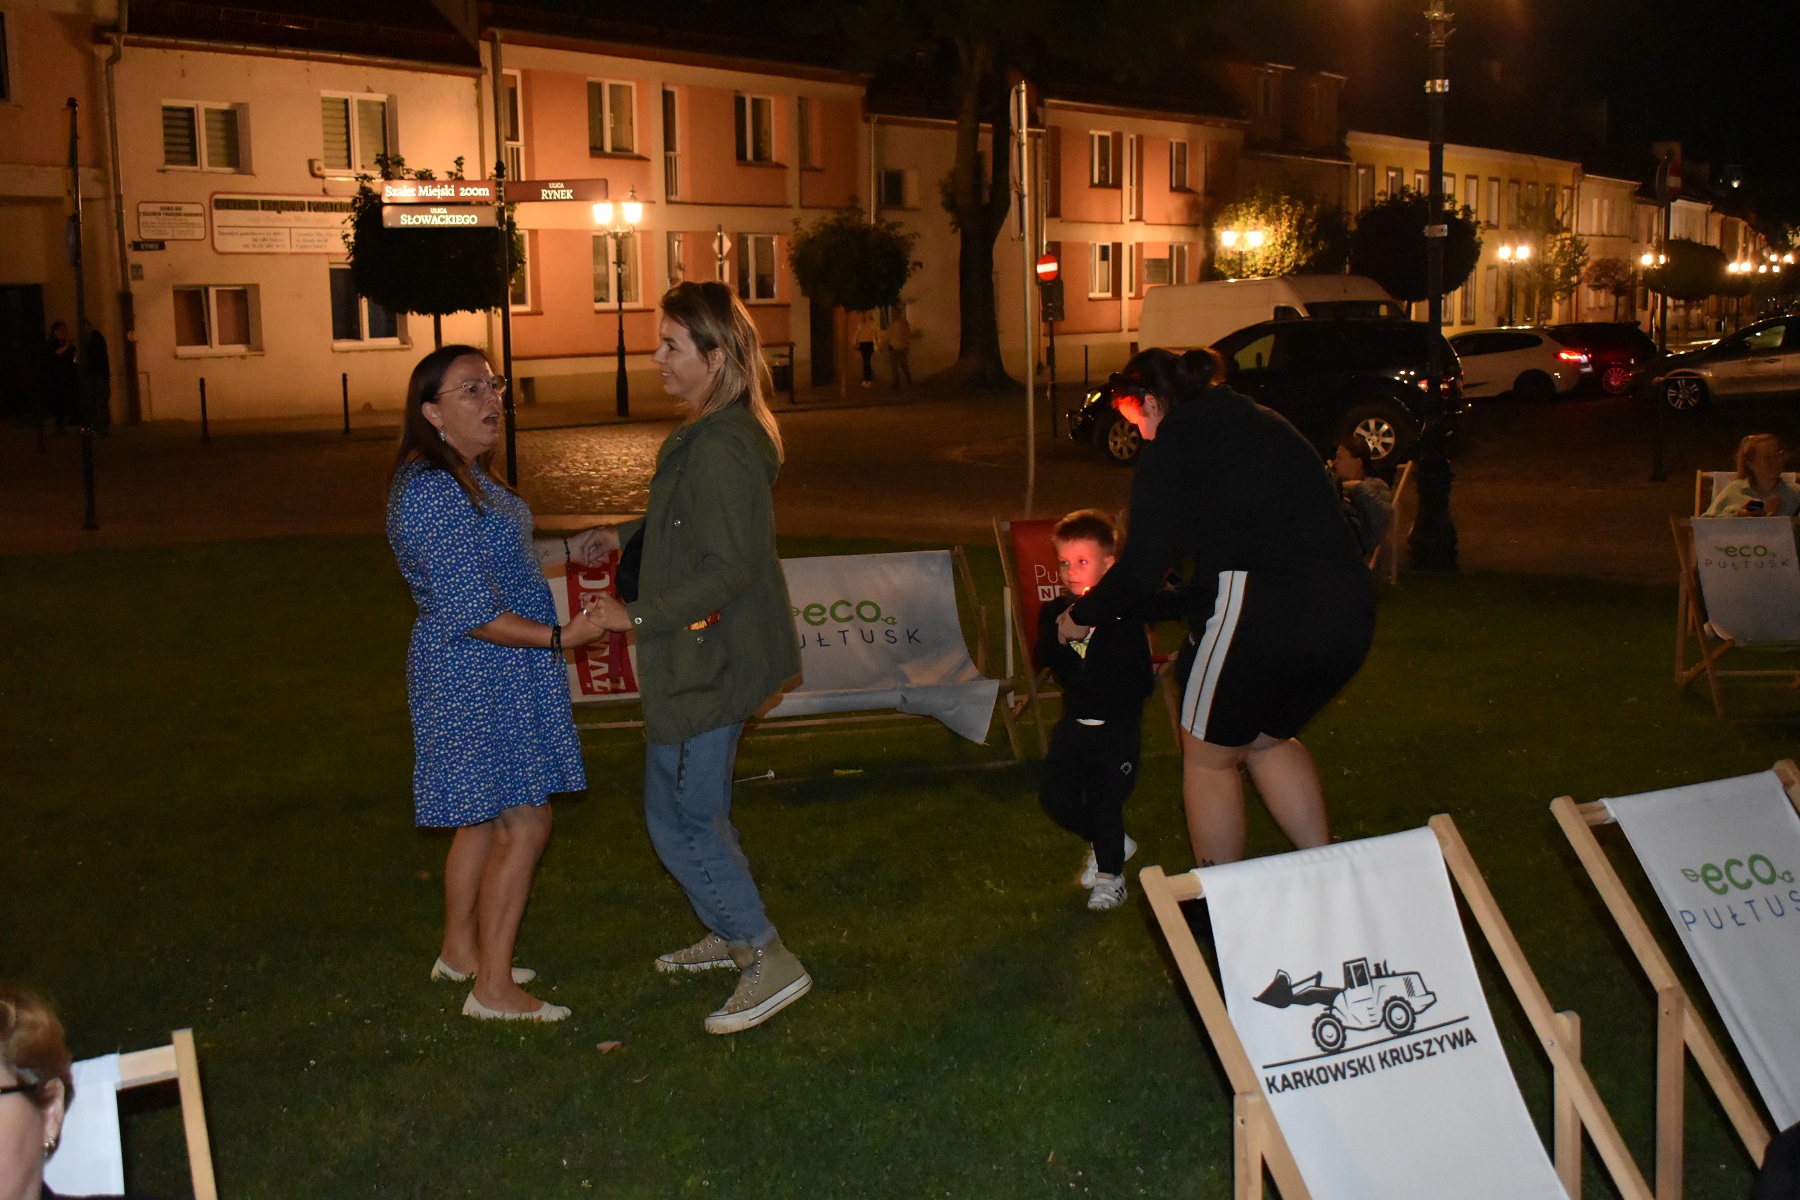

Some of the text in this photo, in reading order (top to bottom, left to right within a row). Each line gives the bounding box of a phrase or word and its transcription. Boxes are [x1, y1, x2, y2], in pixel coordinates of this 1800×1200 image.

[384, 185, 490, 200] Szalet Miejski 200m
[541, 189, 574, 200] RYNEK
[400, 214, 478, 225] SŁOWACKIEGO
[1724, 546, 1768, 558] eco
[1705, 559, 1790, 570] PUŁTUSK
[803, 600, 882, 627] eco
[1701, 853, 1777, 895] eco
[1679, 890, 1800, 932] PUŁTUS
[1265, 1027, 1478, 1094] KARKOWSKI KRUSZYWA
